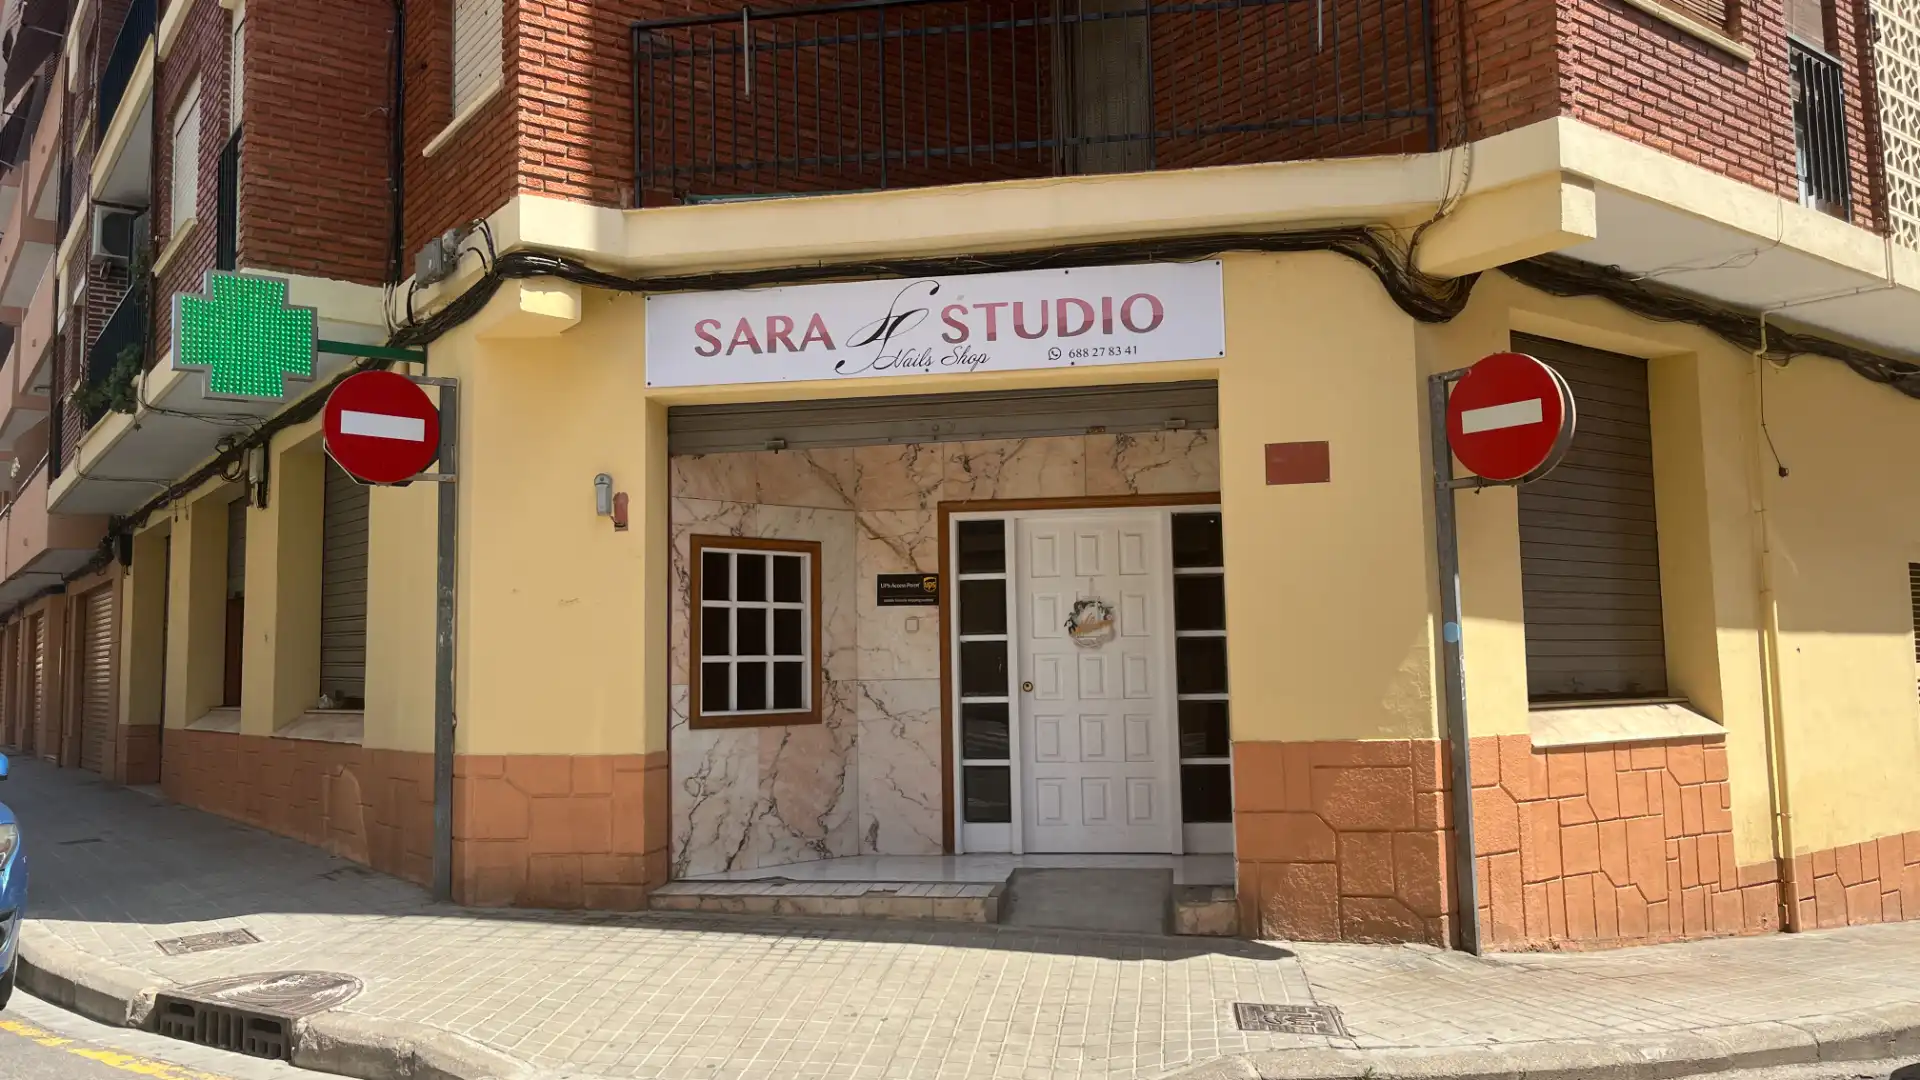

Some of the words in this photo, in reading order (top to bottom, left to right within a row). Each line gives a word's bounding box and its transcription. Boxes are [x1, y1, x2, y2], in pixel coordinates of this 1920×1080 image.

[694, 312, 837, 357] SARA
[940, 292, 1164, 344] STUDIO
[873, 347, 936, 370] Nails
[940, 345, 991, 372] Shop
